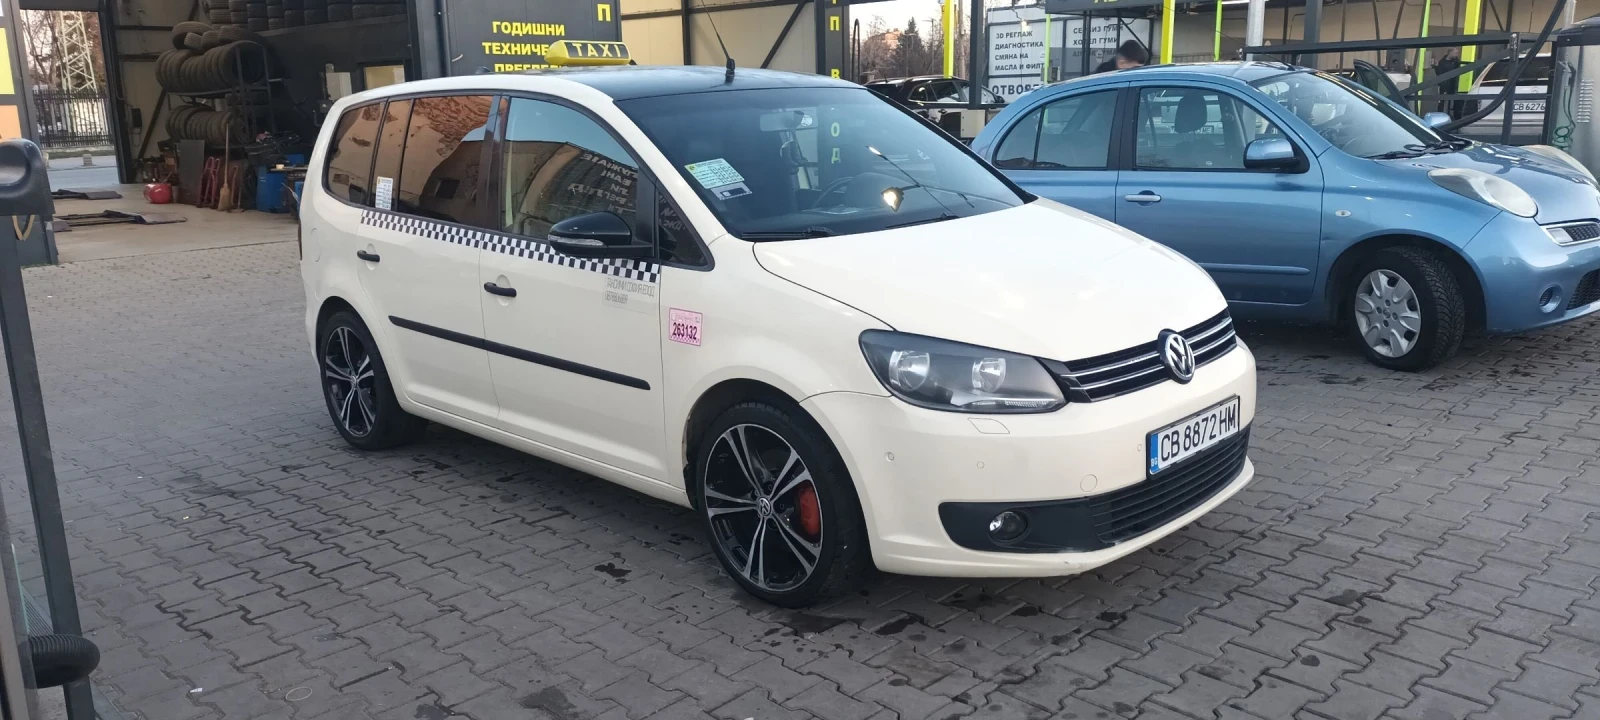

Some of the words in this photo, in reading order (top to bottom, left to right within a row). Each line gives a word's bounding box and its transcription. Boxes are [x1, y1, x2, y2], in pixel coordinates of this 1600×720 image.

[492, 21, 565, 36] ГОДИШНИ
[482, 42, 549, 56] ТЕХНИЧЕ
[572, 43, 622, 58] TAXI
[995, 41, 1044, 50] ДИАГНОСТИКА
[672, 322, 698, 340] 263132
[1160, 429, 1180, 462] CB
[1183, 413, 1217, 452] 8872
[1219, 403, 1236, 436] HM
